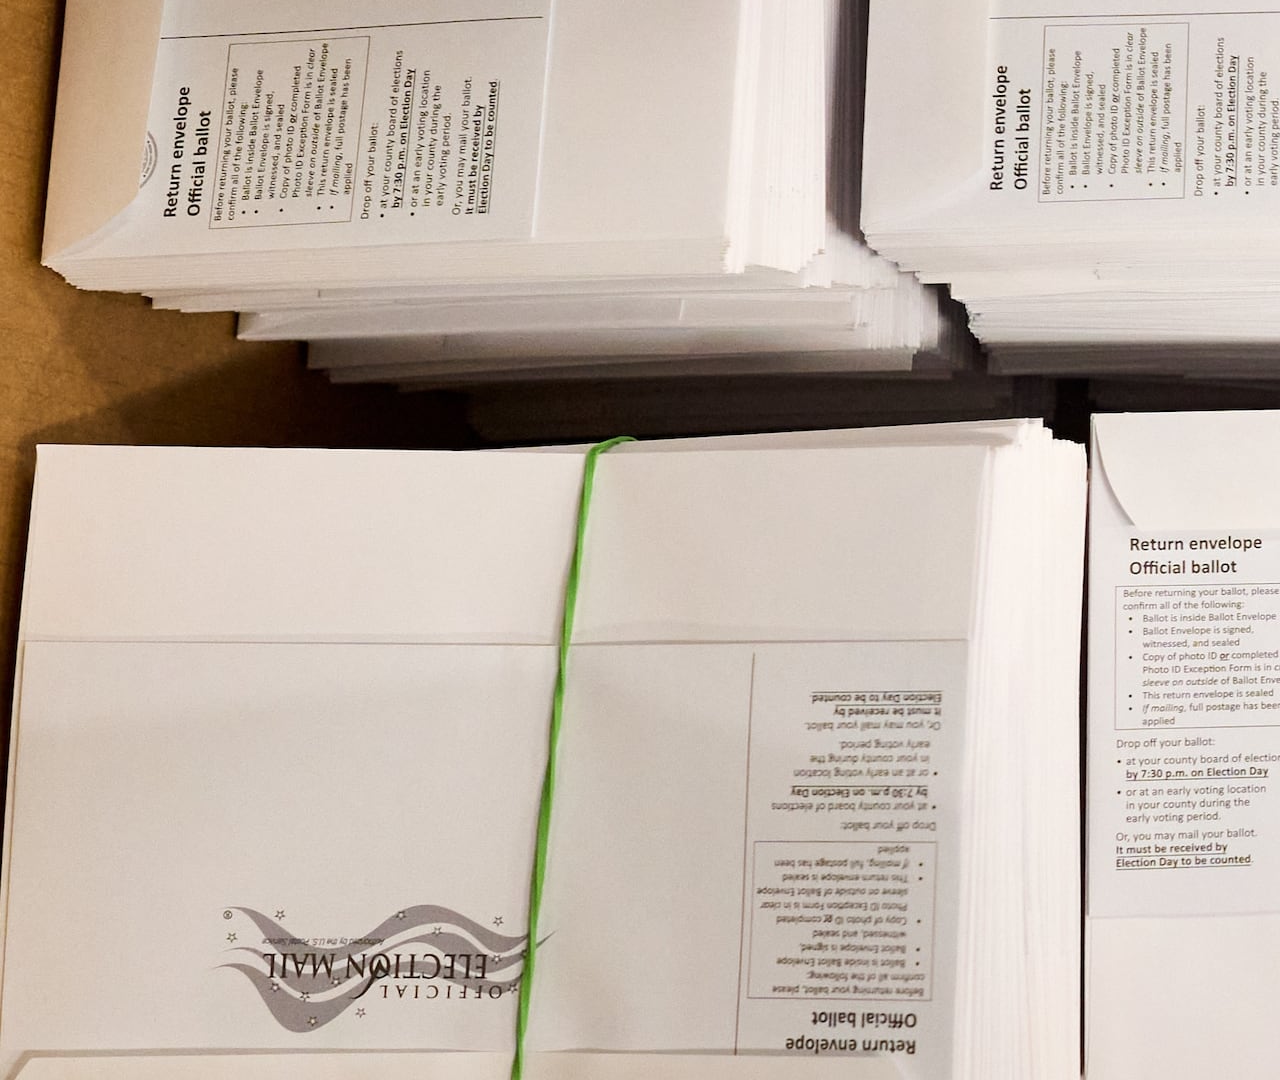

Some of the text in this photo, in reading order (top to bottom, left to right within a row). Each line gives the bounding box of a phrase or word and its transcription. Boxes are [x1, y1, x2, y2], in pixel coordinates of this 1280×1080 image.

[472, 104, 484, 117] by
[483, 124, 494, 137] be
[989, 65, 1010, 190] Return envelope
[391, 68, 415, 208] by 7:30 p.m. on Election Day
[471, 119, 481, 162] received
[483, 139, 493, 150] to
[1013, 88, 1031, 190] Official ballot
[162, 86, 192, 217] Return envelope
[186, 110, 211, 216] Official ballot
[481, 152, 494, 172] Day
[467, 164, 478, 177] be
[467, 179, 476, 205] must
[478, 174, 492, 214] Election
[1129, 535, 1262, 552] Return envelope
[1129, 559, 1237, 575] Official ballot
[1115, 739, 1141, 750] Drop
[1142, 737, 1157, 748] off
[1158, 739, 1182, 749] your
[1125, 757, 1136, 766] at
[1137, 757, 1161, 767] your
[1162, 755, 1198, 766] county
[1199, 753, 1229, 764] board
[1230, 753, 1242, 763] of
[1125, 766, 1269, 780] by 7:30 p.m. on Election Day
[1125, 783, 1266, 797] or at an early voting location
[1125, 797, 1250, 811] in your county during the
[1125, 812, 1151, 824] early
[1152, 812, 1184, 824] voting
[1132, 832, 1151, 843] you
[1153, 832, 1176, 841] may
[1177, 829, 1199, 839] mail
[1201, 830, 1224, 841] your
[1115, 842, 1228, 854] It must be received by
[1115, 857, 1156, 869] Election
[1158, 856, 1179, 868] Day
[1180, 857, 1192, 868] to
[1194, 855, 1207, 868] be
[262, 953, 488, 979] ELECTION MAIL
[378, 984, 503, 999] OFFICIAL
[811, 1010, 917, 1029] Official ballot
[785, 1035, 916, 1055] Return envelope
